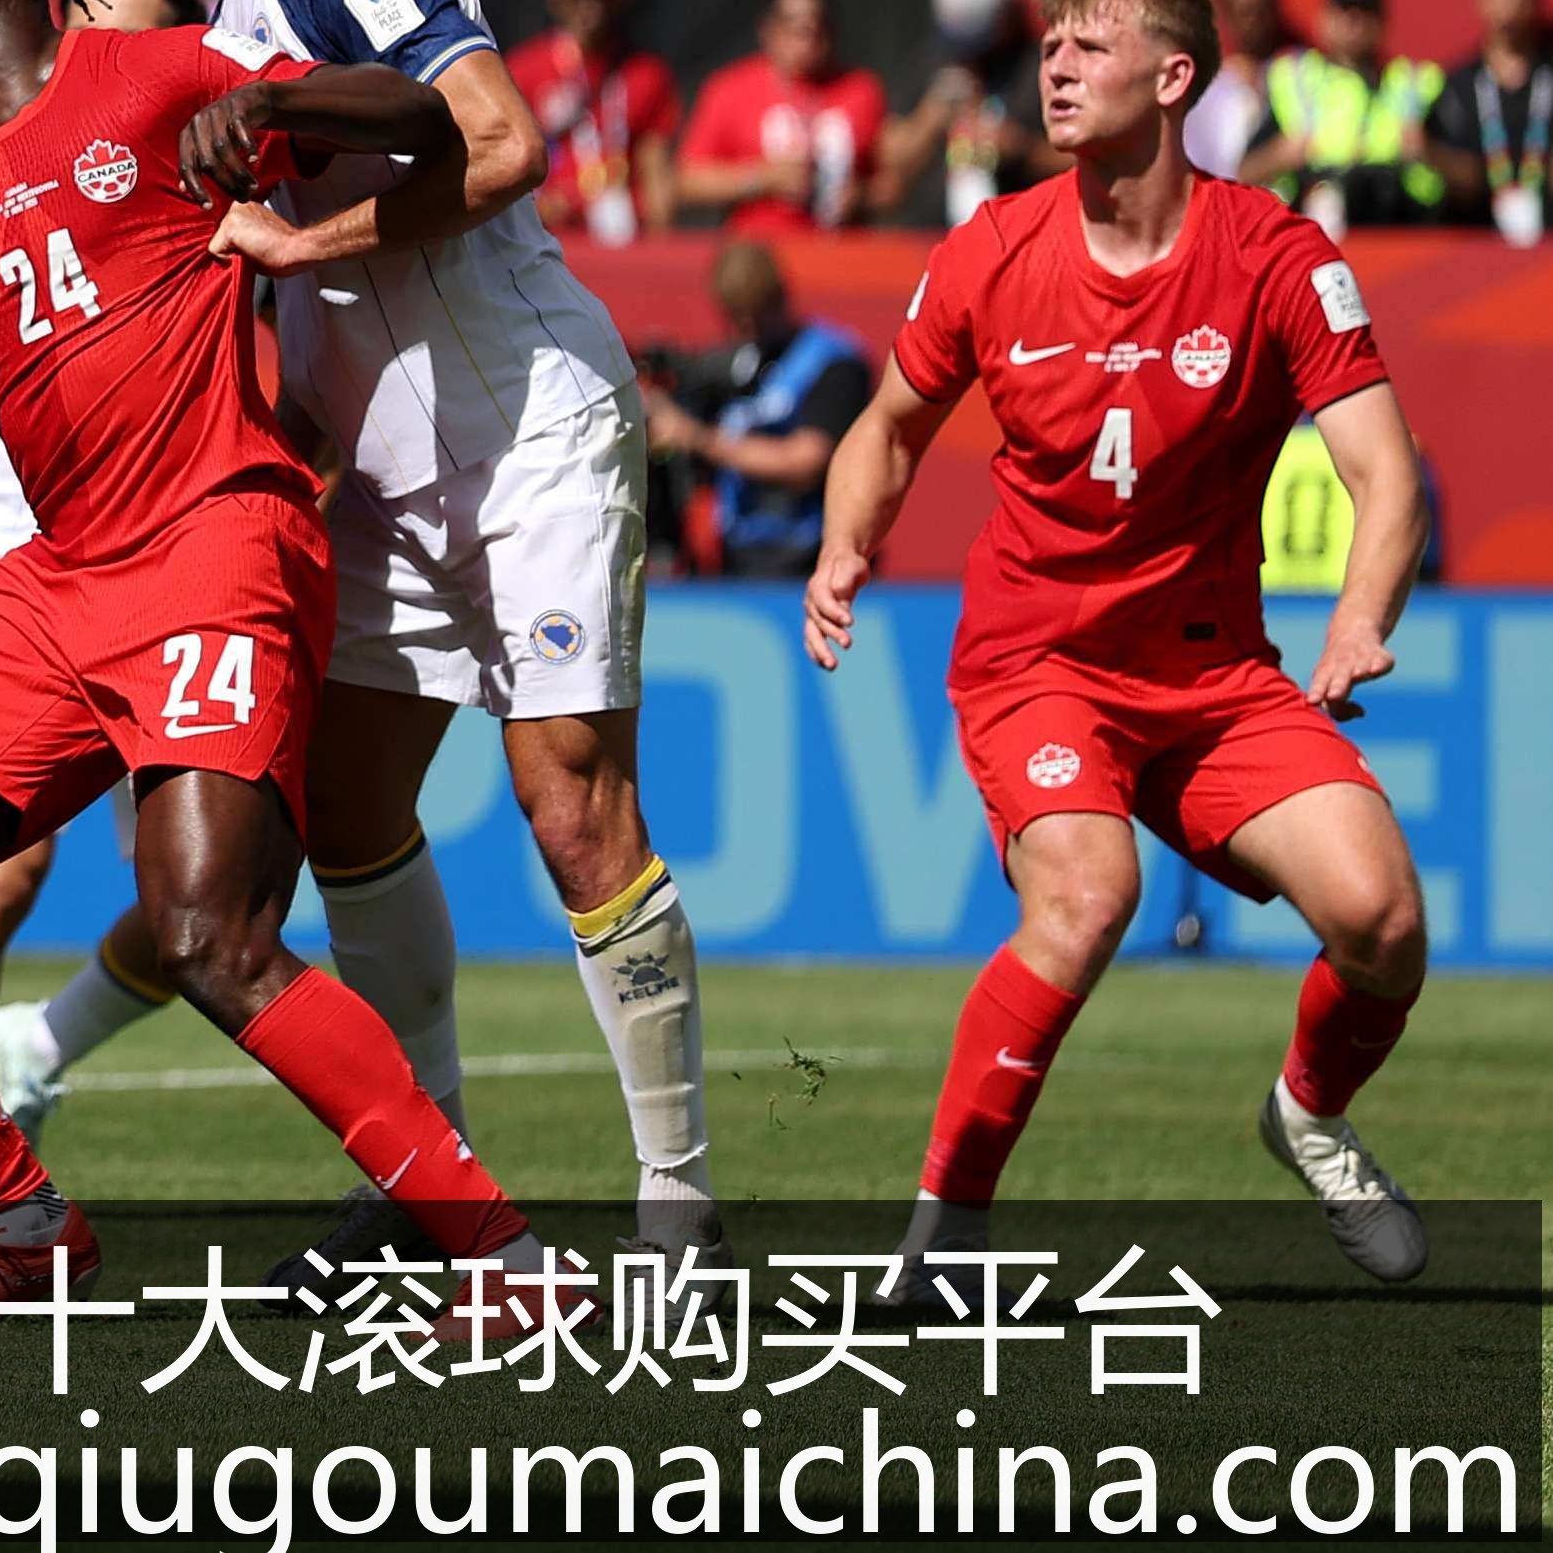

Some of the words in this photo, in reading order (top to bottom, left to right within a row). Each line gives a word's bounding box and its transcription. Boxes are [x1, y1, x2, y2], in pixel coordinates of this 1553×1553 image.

[78, 161, 136, 183] CANADA
[1090, 407, 1138, 500] 4
[161, 633, 256, 725] 24
